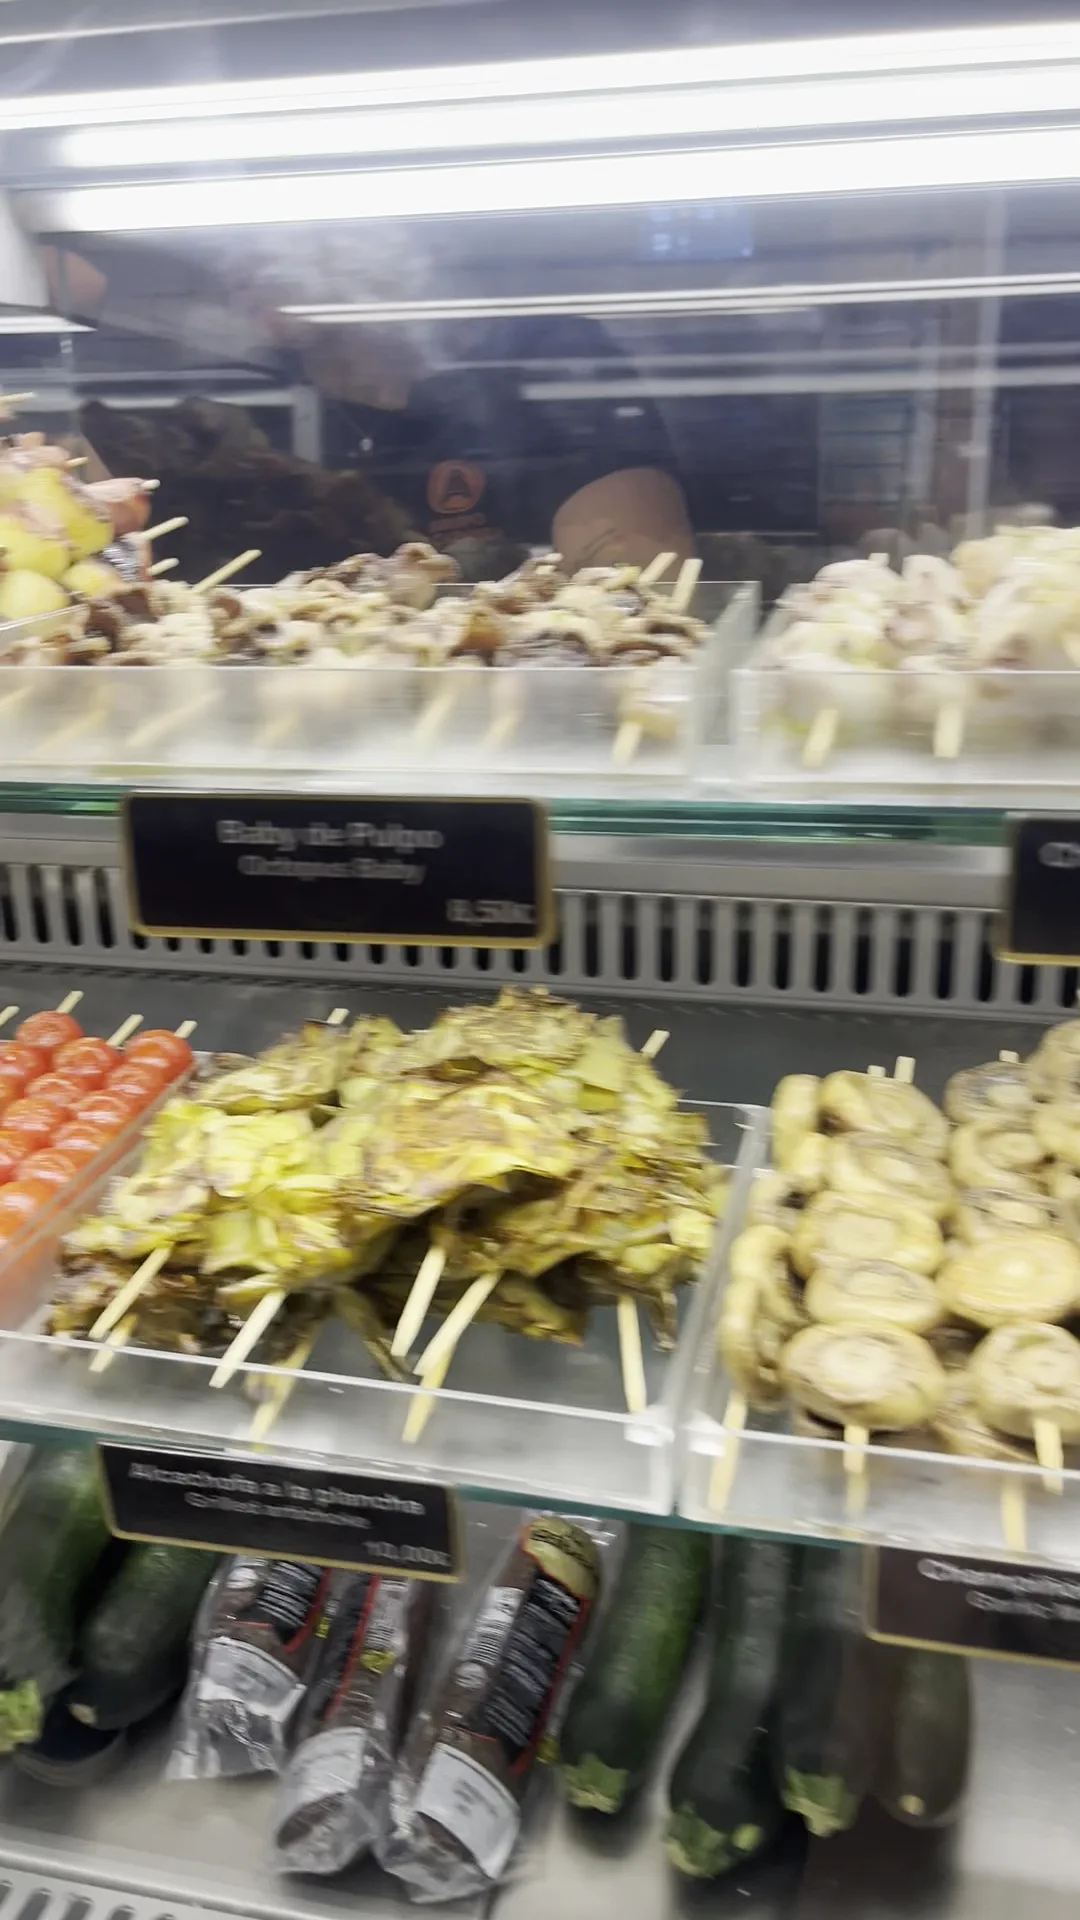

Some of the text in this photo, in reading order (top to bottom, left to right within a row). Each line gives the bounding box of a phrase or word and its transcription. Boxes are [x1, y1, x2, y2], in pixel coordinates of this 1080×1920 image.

[216, 820, 444, 853] Baby de Pulpo
[128, 1462, 258, 1493] Alcachofa
[284, 1481, 312, 1500] la
[312, 1486, 426, 1515] plancha
